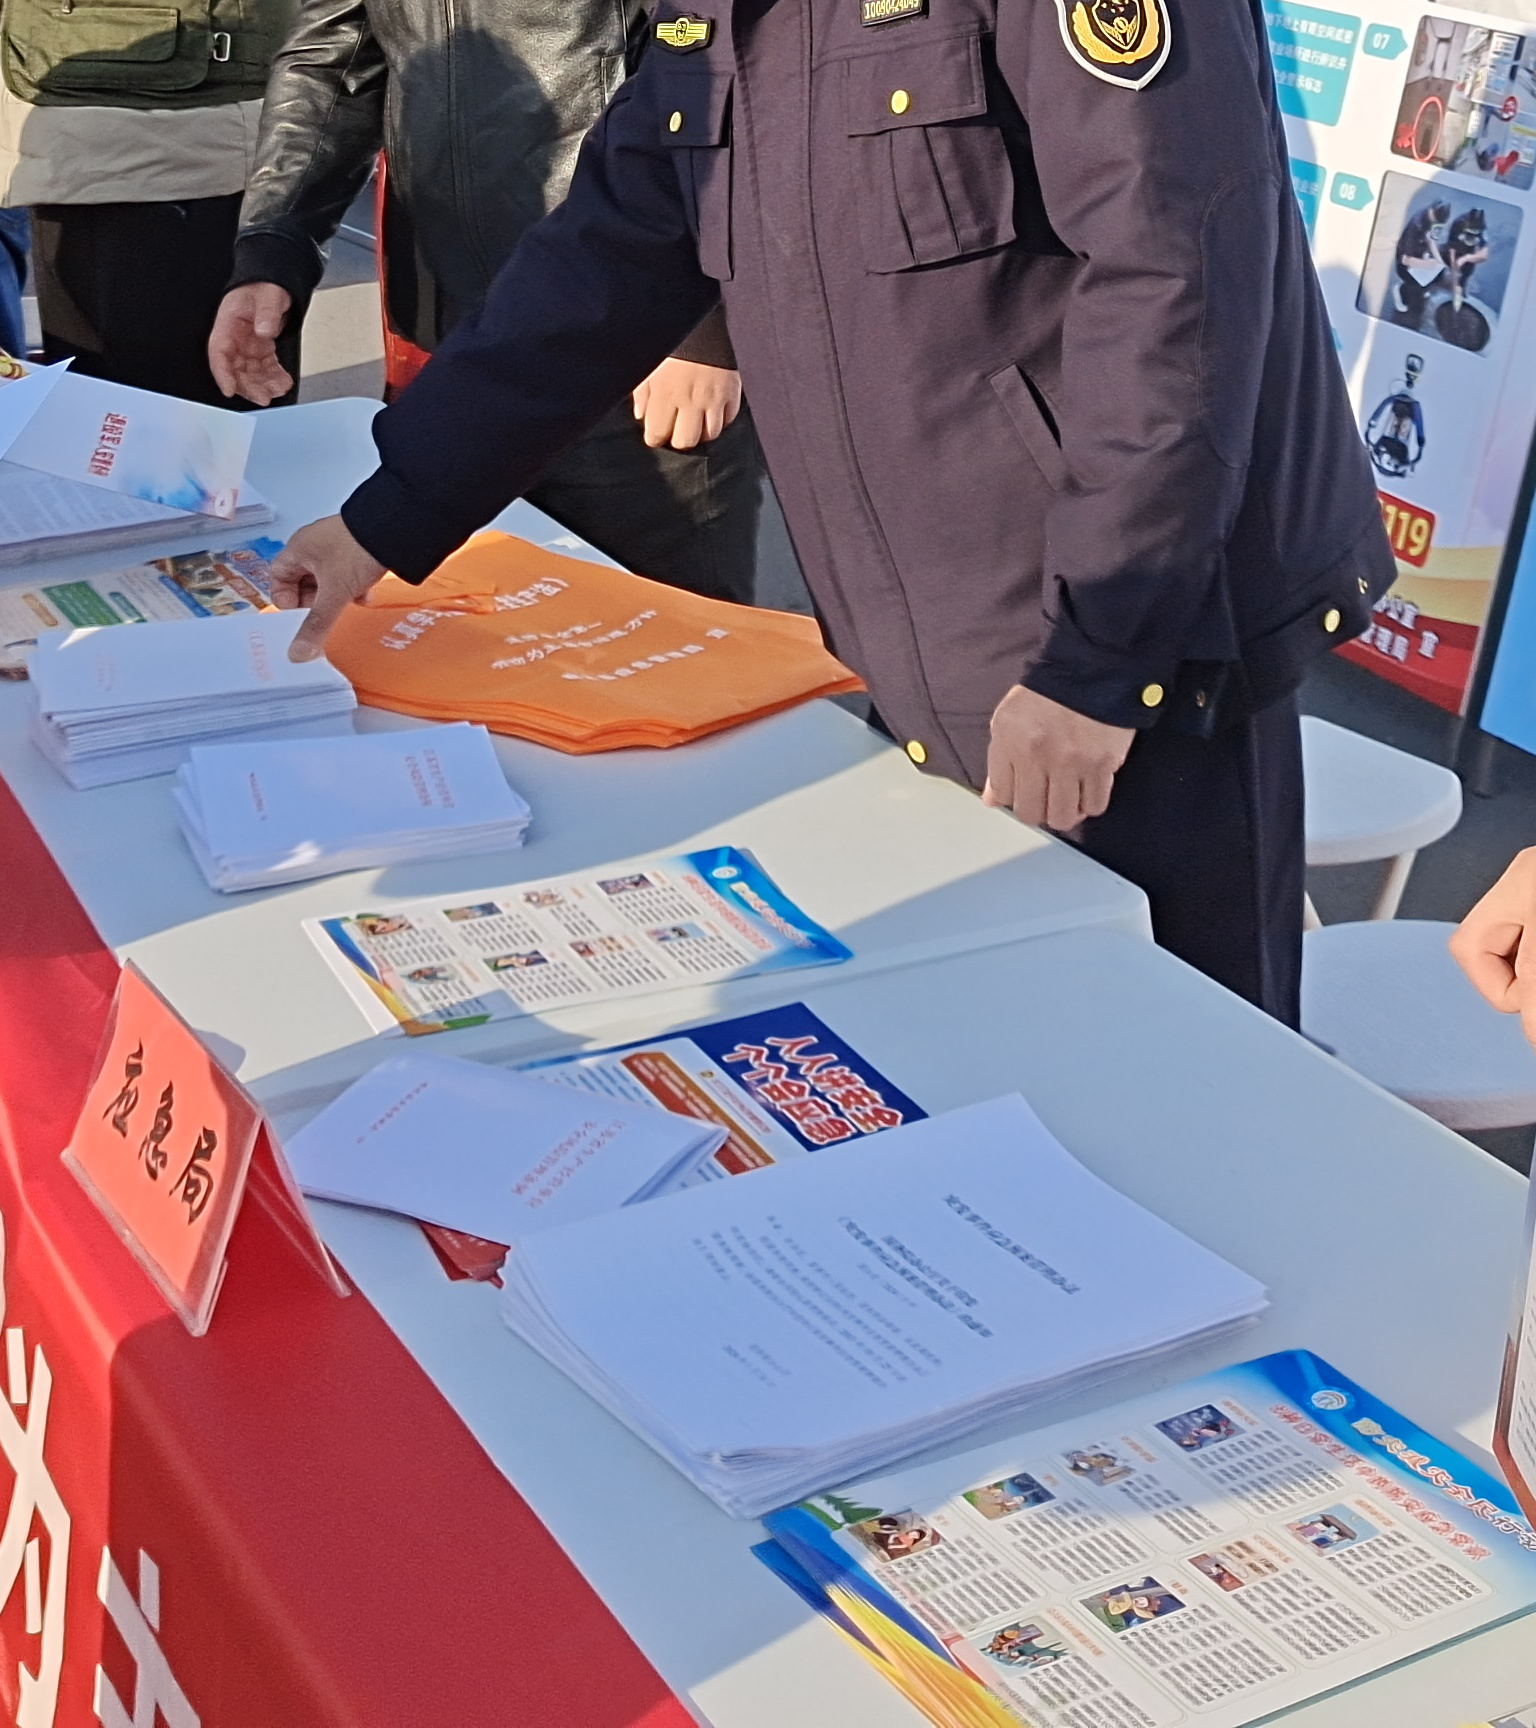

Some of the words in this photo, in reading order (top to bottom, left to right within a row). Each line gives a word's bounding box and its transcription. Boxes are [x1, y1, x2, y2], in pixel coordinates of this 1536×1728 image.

[1372, 31, 1391, 50] 07
[1339, 182, 1356, 201] 08
[1377, 498, 1430, 557] 119
[722, 1043, 860, 1146] 个个会应急
[765, 1035, 903, 1134] 人人讲安全
